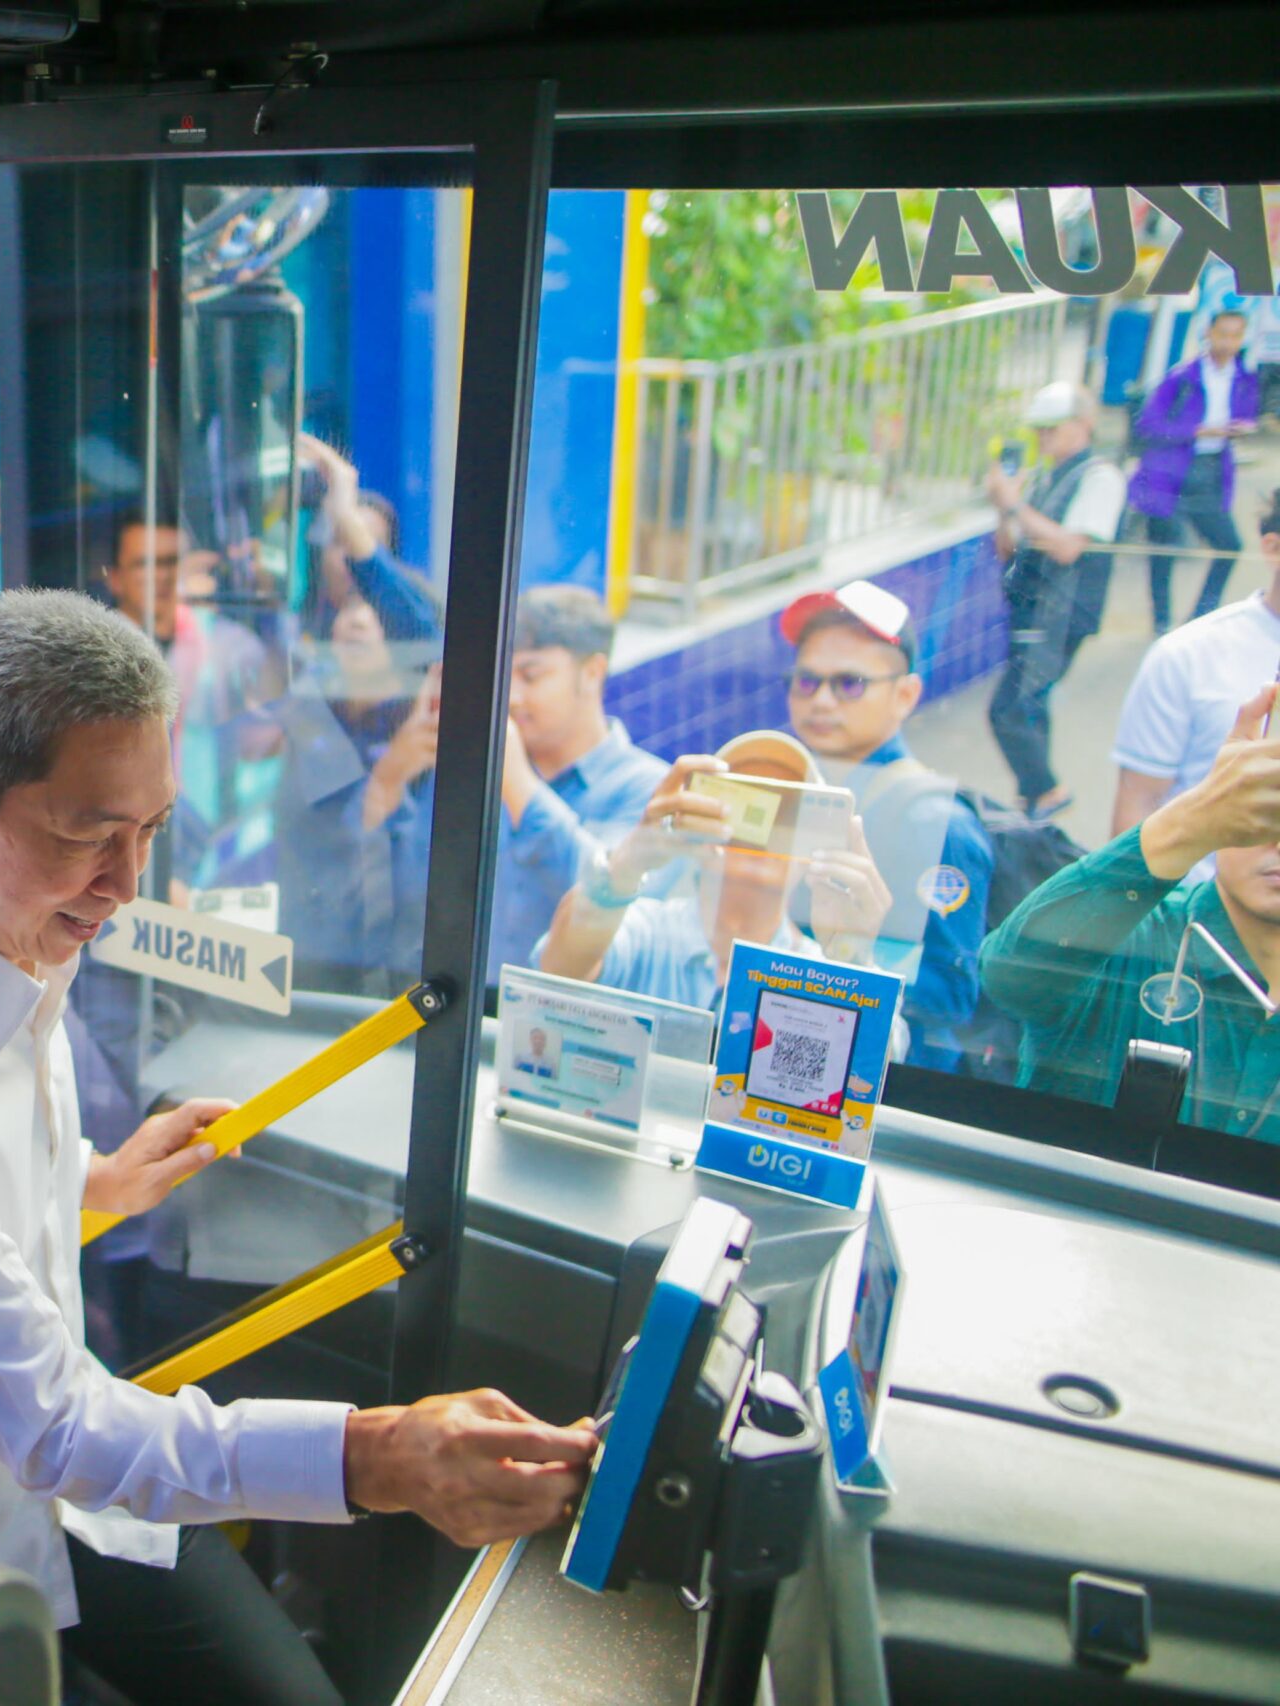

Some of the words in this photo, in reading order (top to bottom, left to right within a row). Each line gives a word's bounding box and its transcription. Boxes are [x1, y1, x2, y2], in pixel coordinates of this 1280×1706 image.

[747, 969, 803, 991] Tinggal
[804, 981, 848, 1001] SCAN
[848, 992, 880, 1009] Aja!
[770, 960, 804, 977] Mau
[806, 967, 860, 989] Bayar?
[747, 1143, 812, 1181] DIGI
